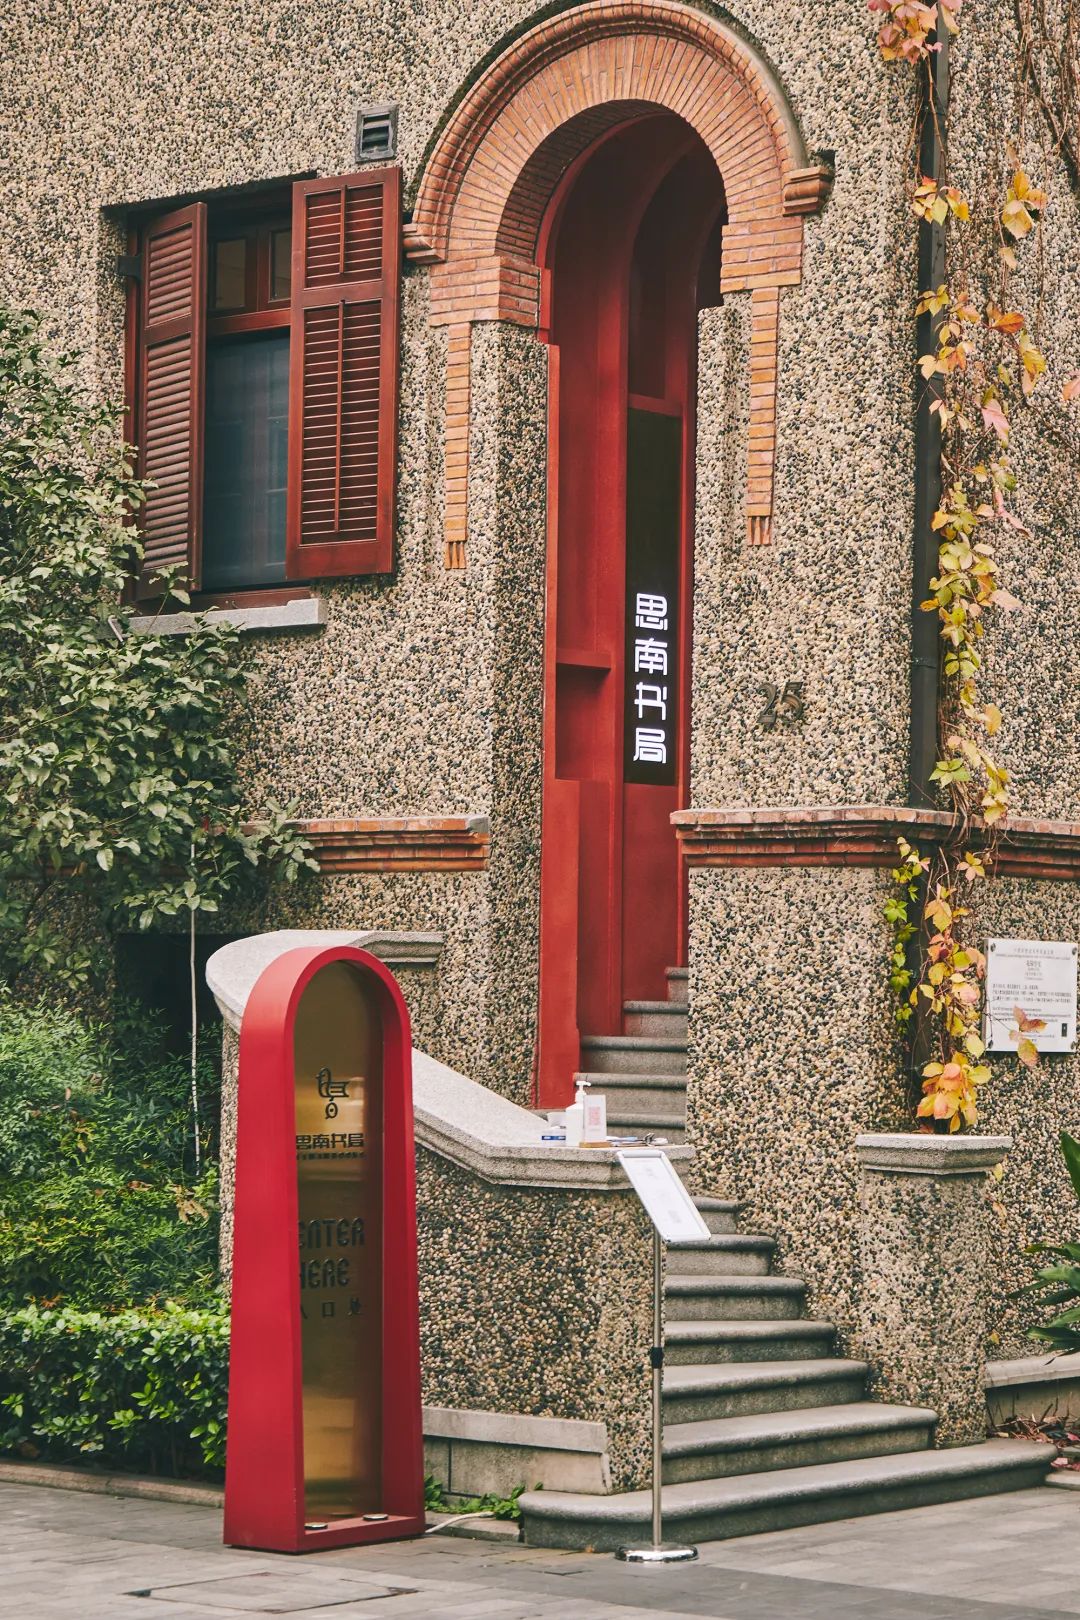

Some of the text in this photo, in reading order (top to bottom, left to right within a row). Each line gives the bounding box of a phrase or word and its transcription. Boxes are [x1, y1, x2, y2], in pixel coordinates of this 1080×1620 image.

[633, 592, 668, 764] 思南书局
[756, 681, 803, 726] 25
[296, 1133, 364, 1150] 思南书局
